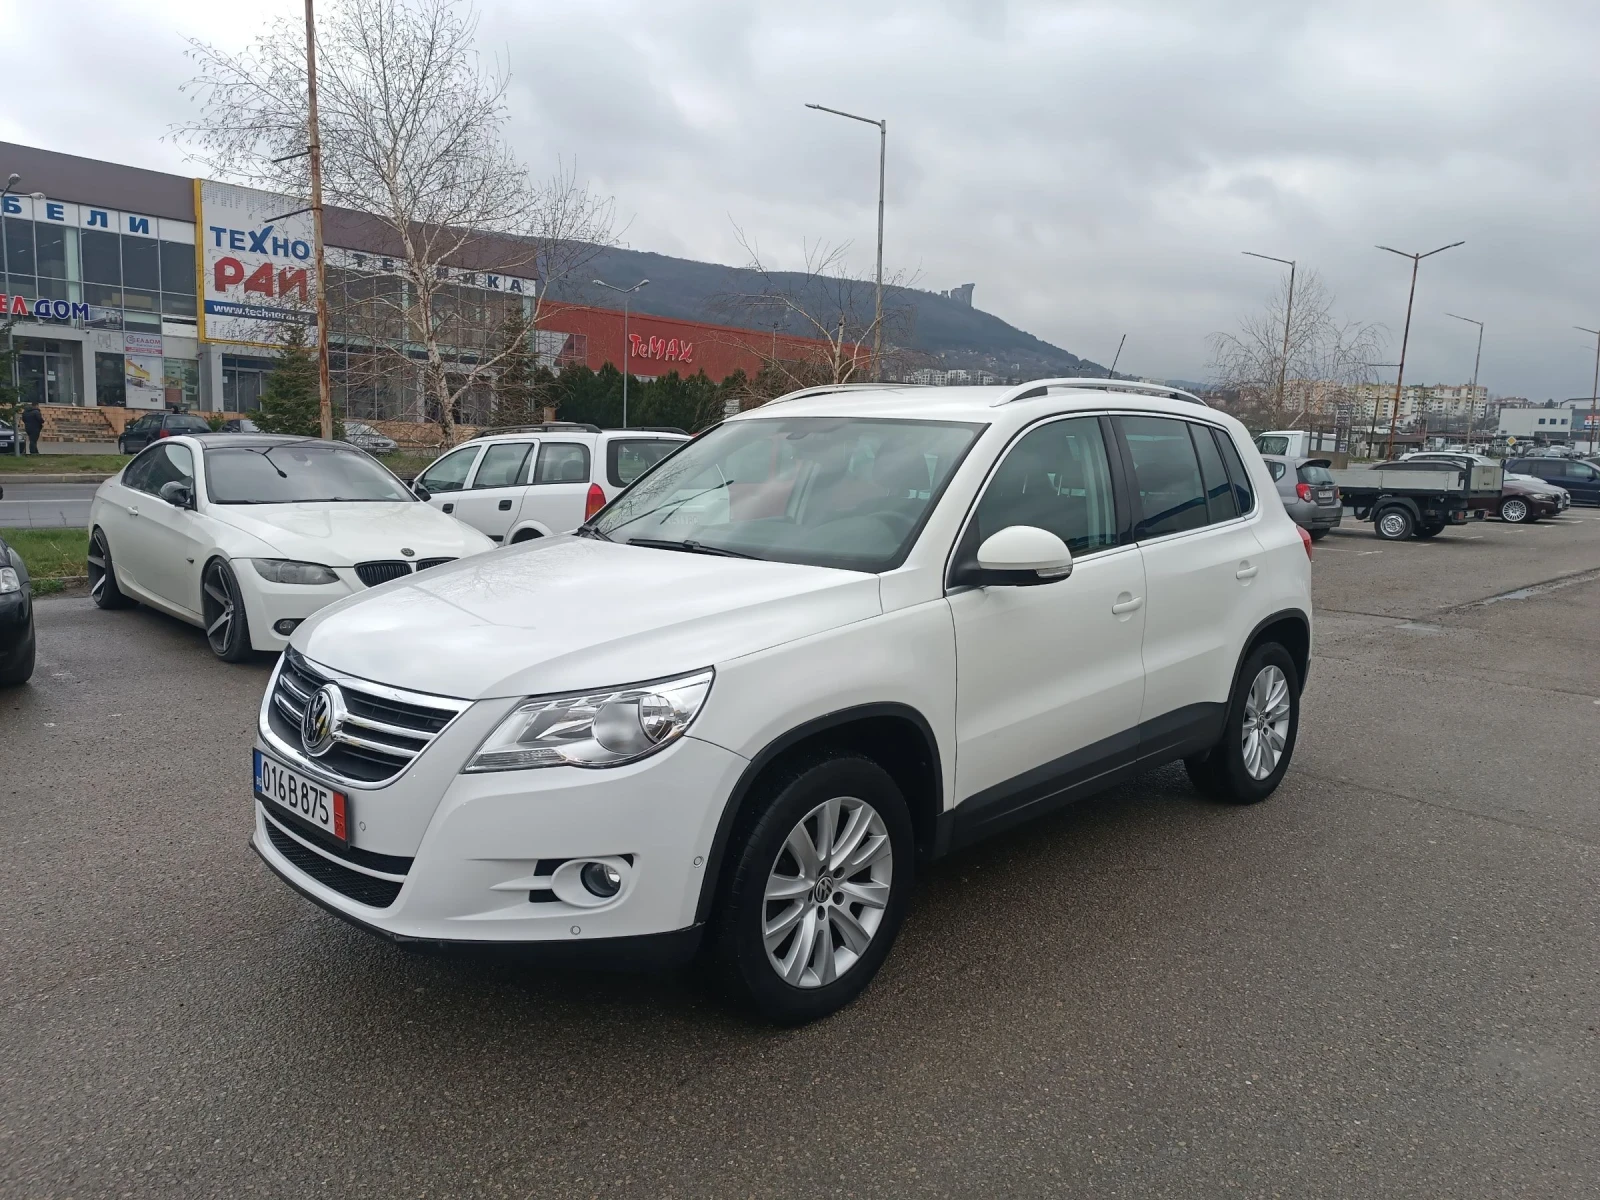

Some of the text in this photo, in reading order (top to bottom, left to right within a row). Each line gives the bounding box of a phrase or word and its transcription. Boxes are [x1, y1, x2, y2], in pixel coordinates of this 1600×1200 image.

[3, 196, 149, 234] БЕЛИ
[210, 225, 310, 260] ТЕХНО
[352, 253, 522, 292] ТЕНИКА
[262, 761, 329, 825] 016B875
